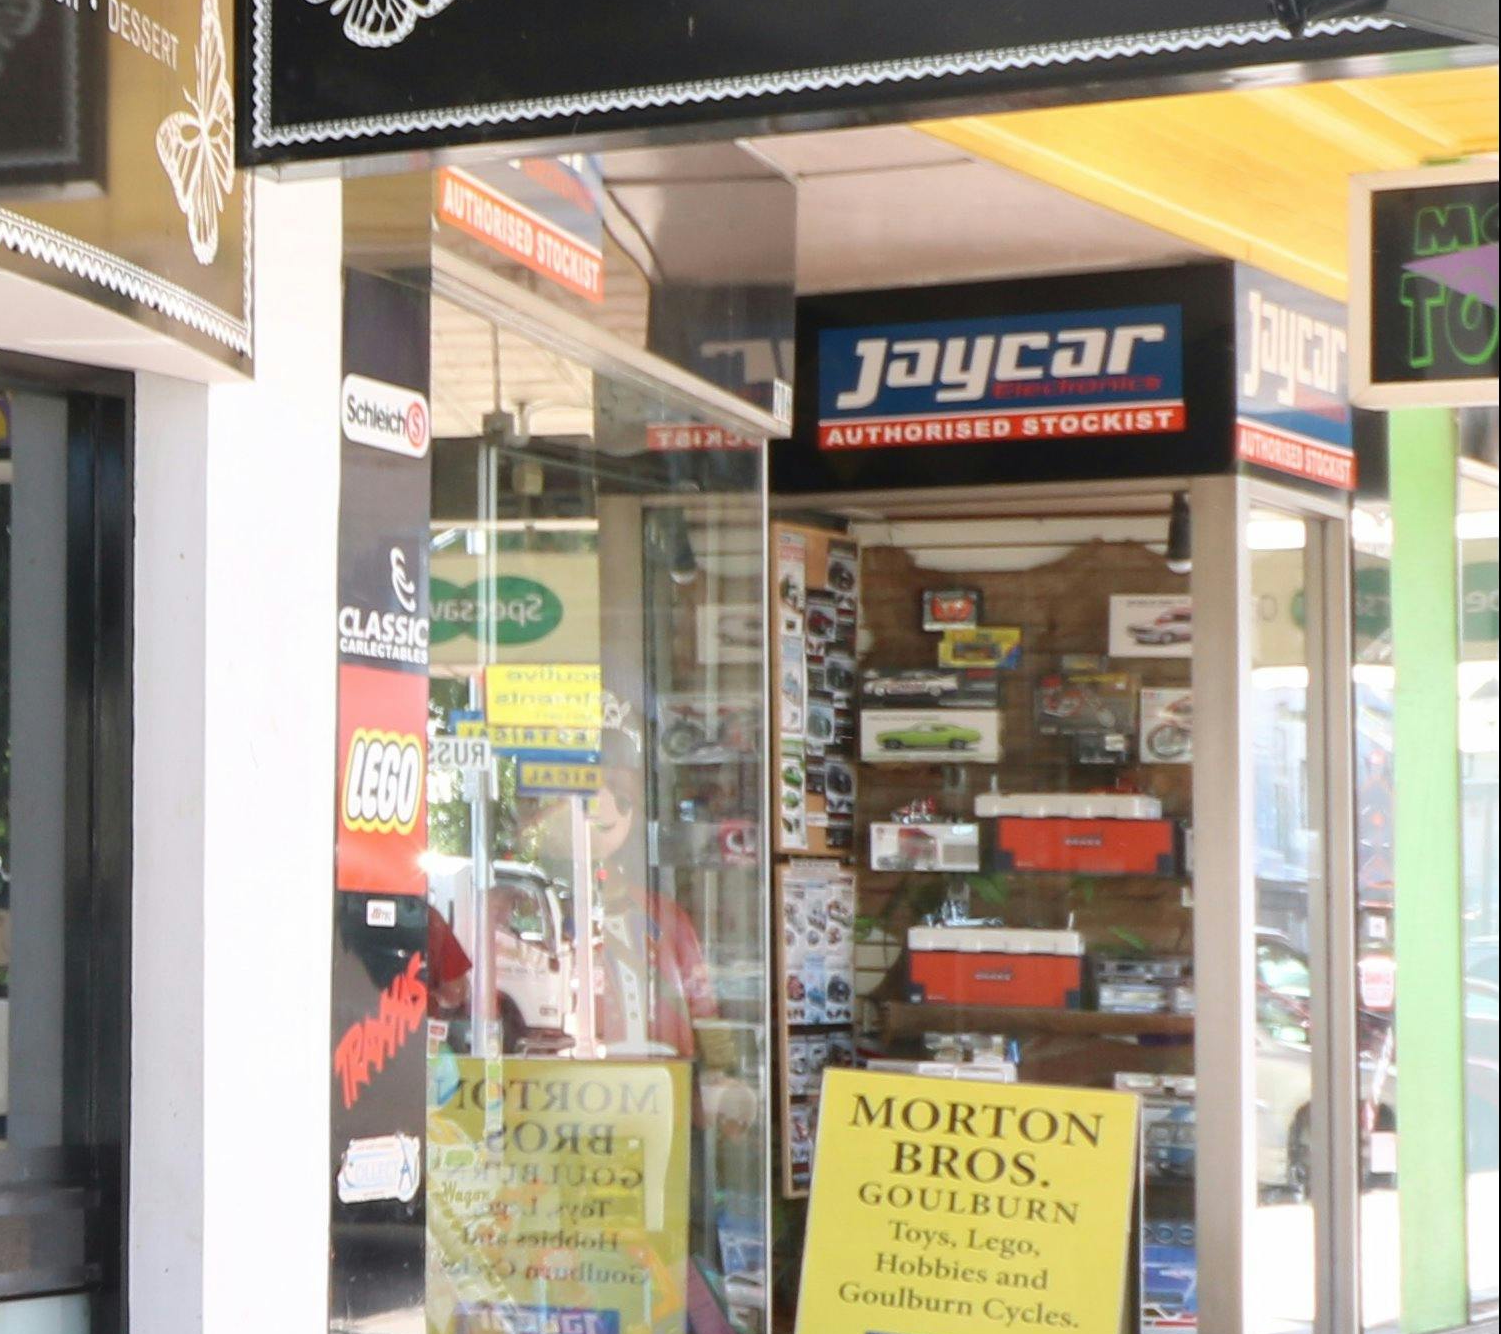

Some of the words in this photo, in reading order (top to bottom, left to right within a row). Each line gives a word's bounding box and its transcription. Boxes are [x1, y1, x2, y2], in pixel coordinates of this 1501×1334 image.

[442, 178, 534, 257] AUTHORISED
[536, 232, 600, 293] STOCKIST
[345, 395, 407, 440] Schleich
[825, 415, 1011, 447] AUTHORISED
[1021, 408, 1174, 437] STOCKIST
[338, 606, 429, 648] CLASSIC
[339, 637, 429, 665] CARLECTABLES
[345, 739, 420, 827] LEGO
[849, 1093, 1105, 1148] MORTON
[892, 1140, 1051, 1188] BROS.
[858, 1182, 1079, 1226] GOULBURN
[968, 1228, 1041, 1258] Lego,
[875, 1252, 988, 1285] Hobbies
[996, 1267, 1049, 1292] and
[839, 1282, 973, 1317] Goulburn
[983, 1297, 1080, 1329] Cycles.
